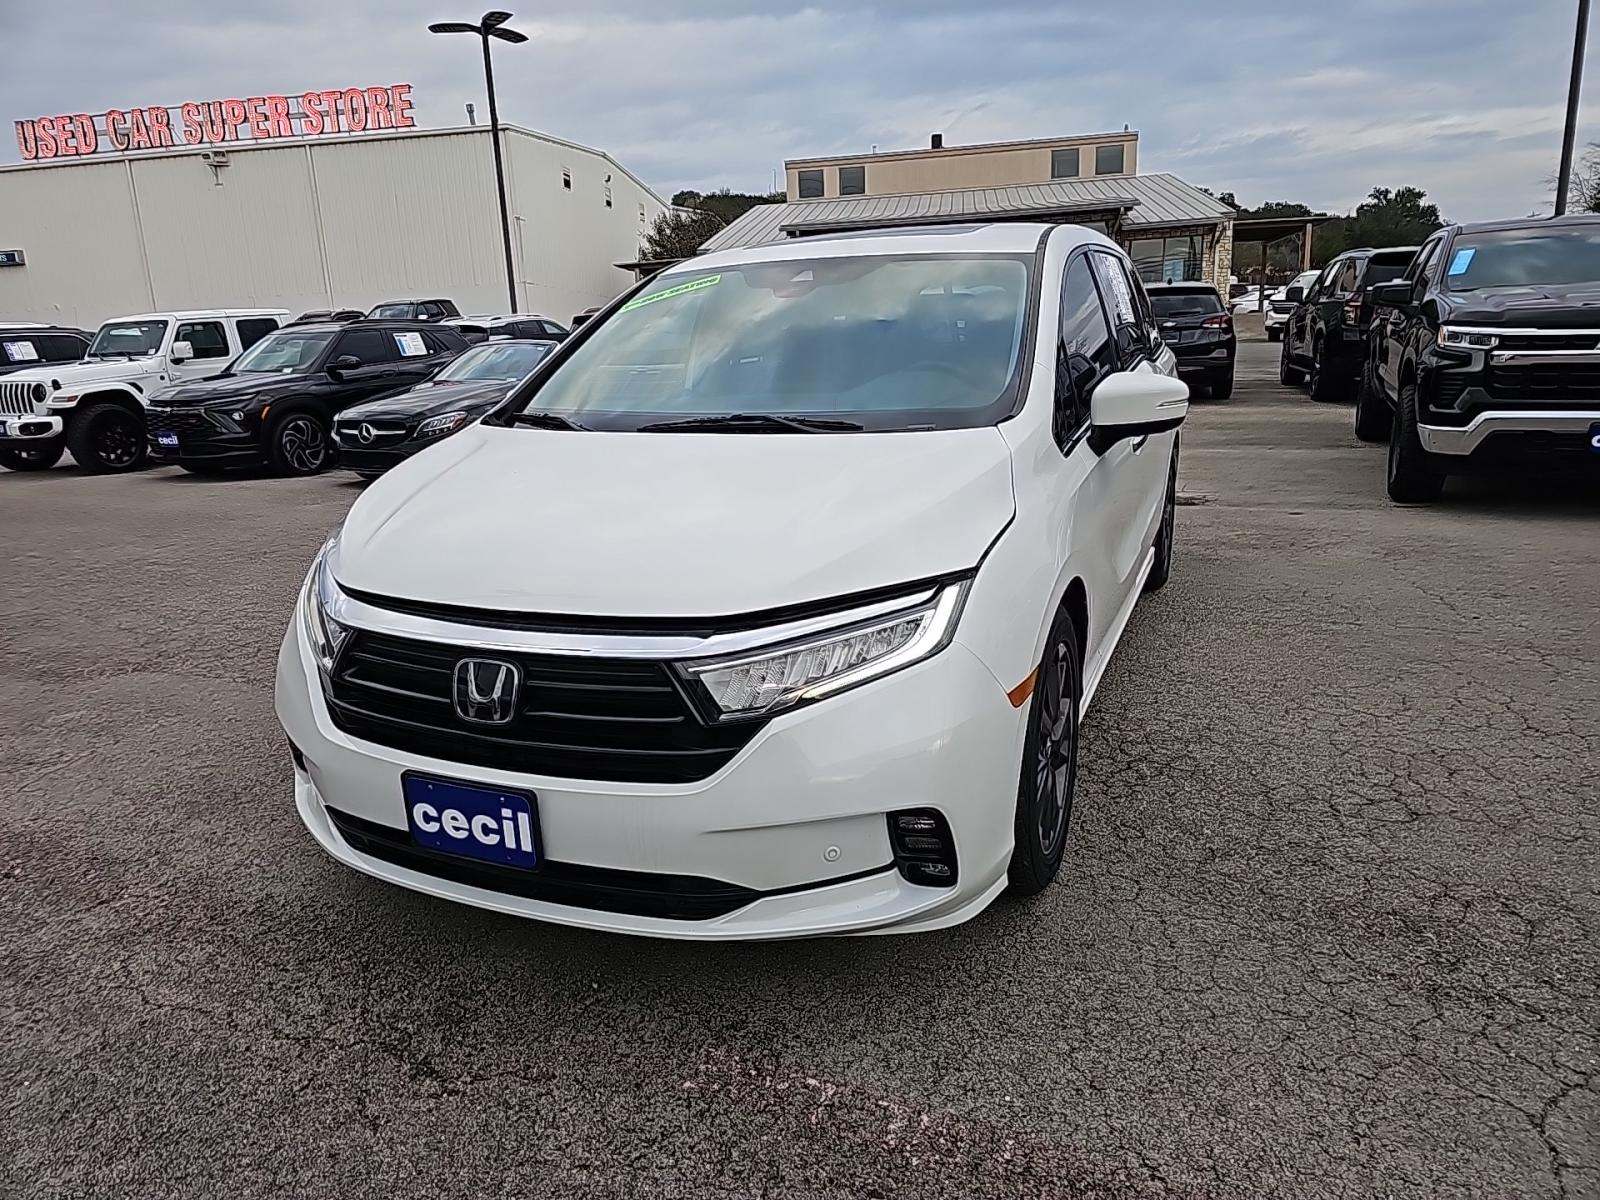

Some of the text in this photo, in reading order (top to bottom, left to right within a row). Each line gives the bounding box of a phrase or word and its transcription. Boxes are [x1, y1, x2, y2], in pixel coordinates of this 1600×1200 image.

[14, 83, 417, 160] USED CAR SUPER STORE
[158, 435, 178, 445] cecil
[413, 803, 533, 852] cecil
